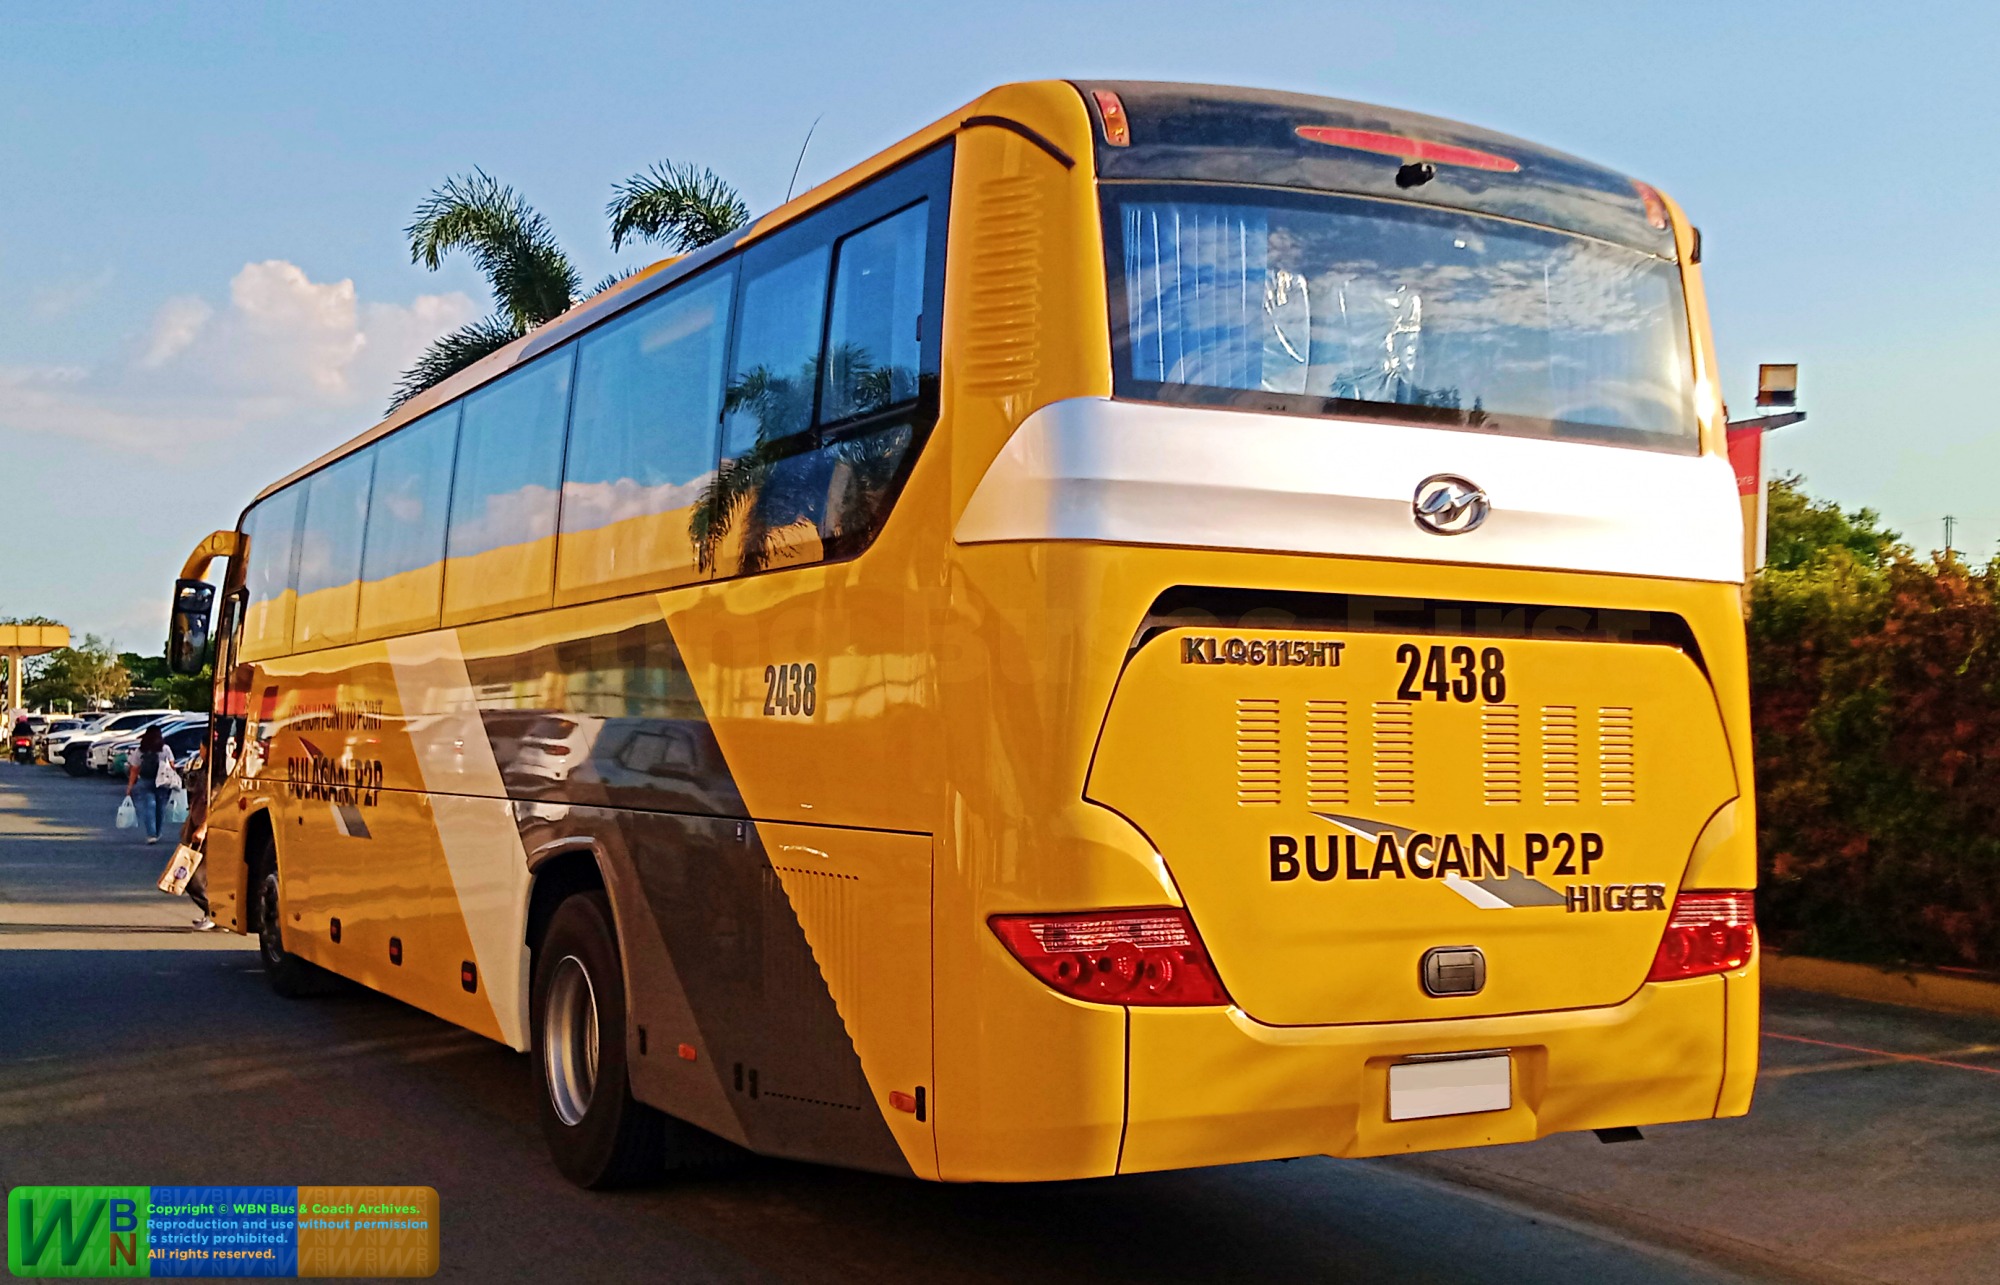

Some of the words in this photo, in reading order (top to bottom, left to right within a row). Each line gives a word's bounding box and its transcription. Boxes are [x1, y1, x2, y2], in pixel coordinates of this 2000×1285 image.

[1180, 637, 1345, 667] KLQ6115HT
[1396, 643, 1506, 703] 2438
[763, 663, 817, 717] 2438
[288, 756, 349, 807] BULACAN
[355, 759, 383, 807] P2P
[1269, 831, 1509, 882] BULACAN
[1525, 832, 1605, 877] P2P
[1565, 883, 1668, 912] HIGER
